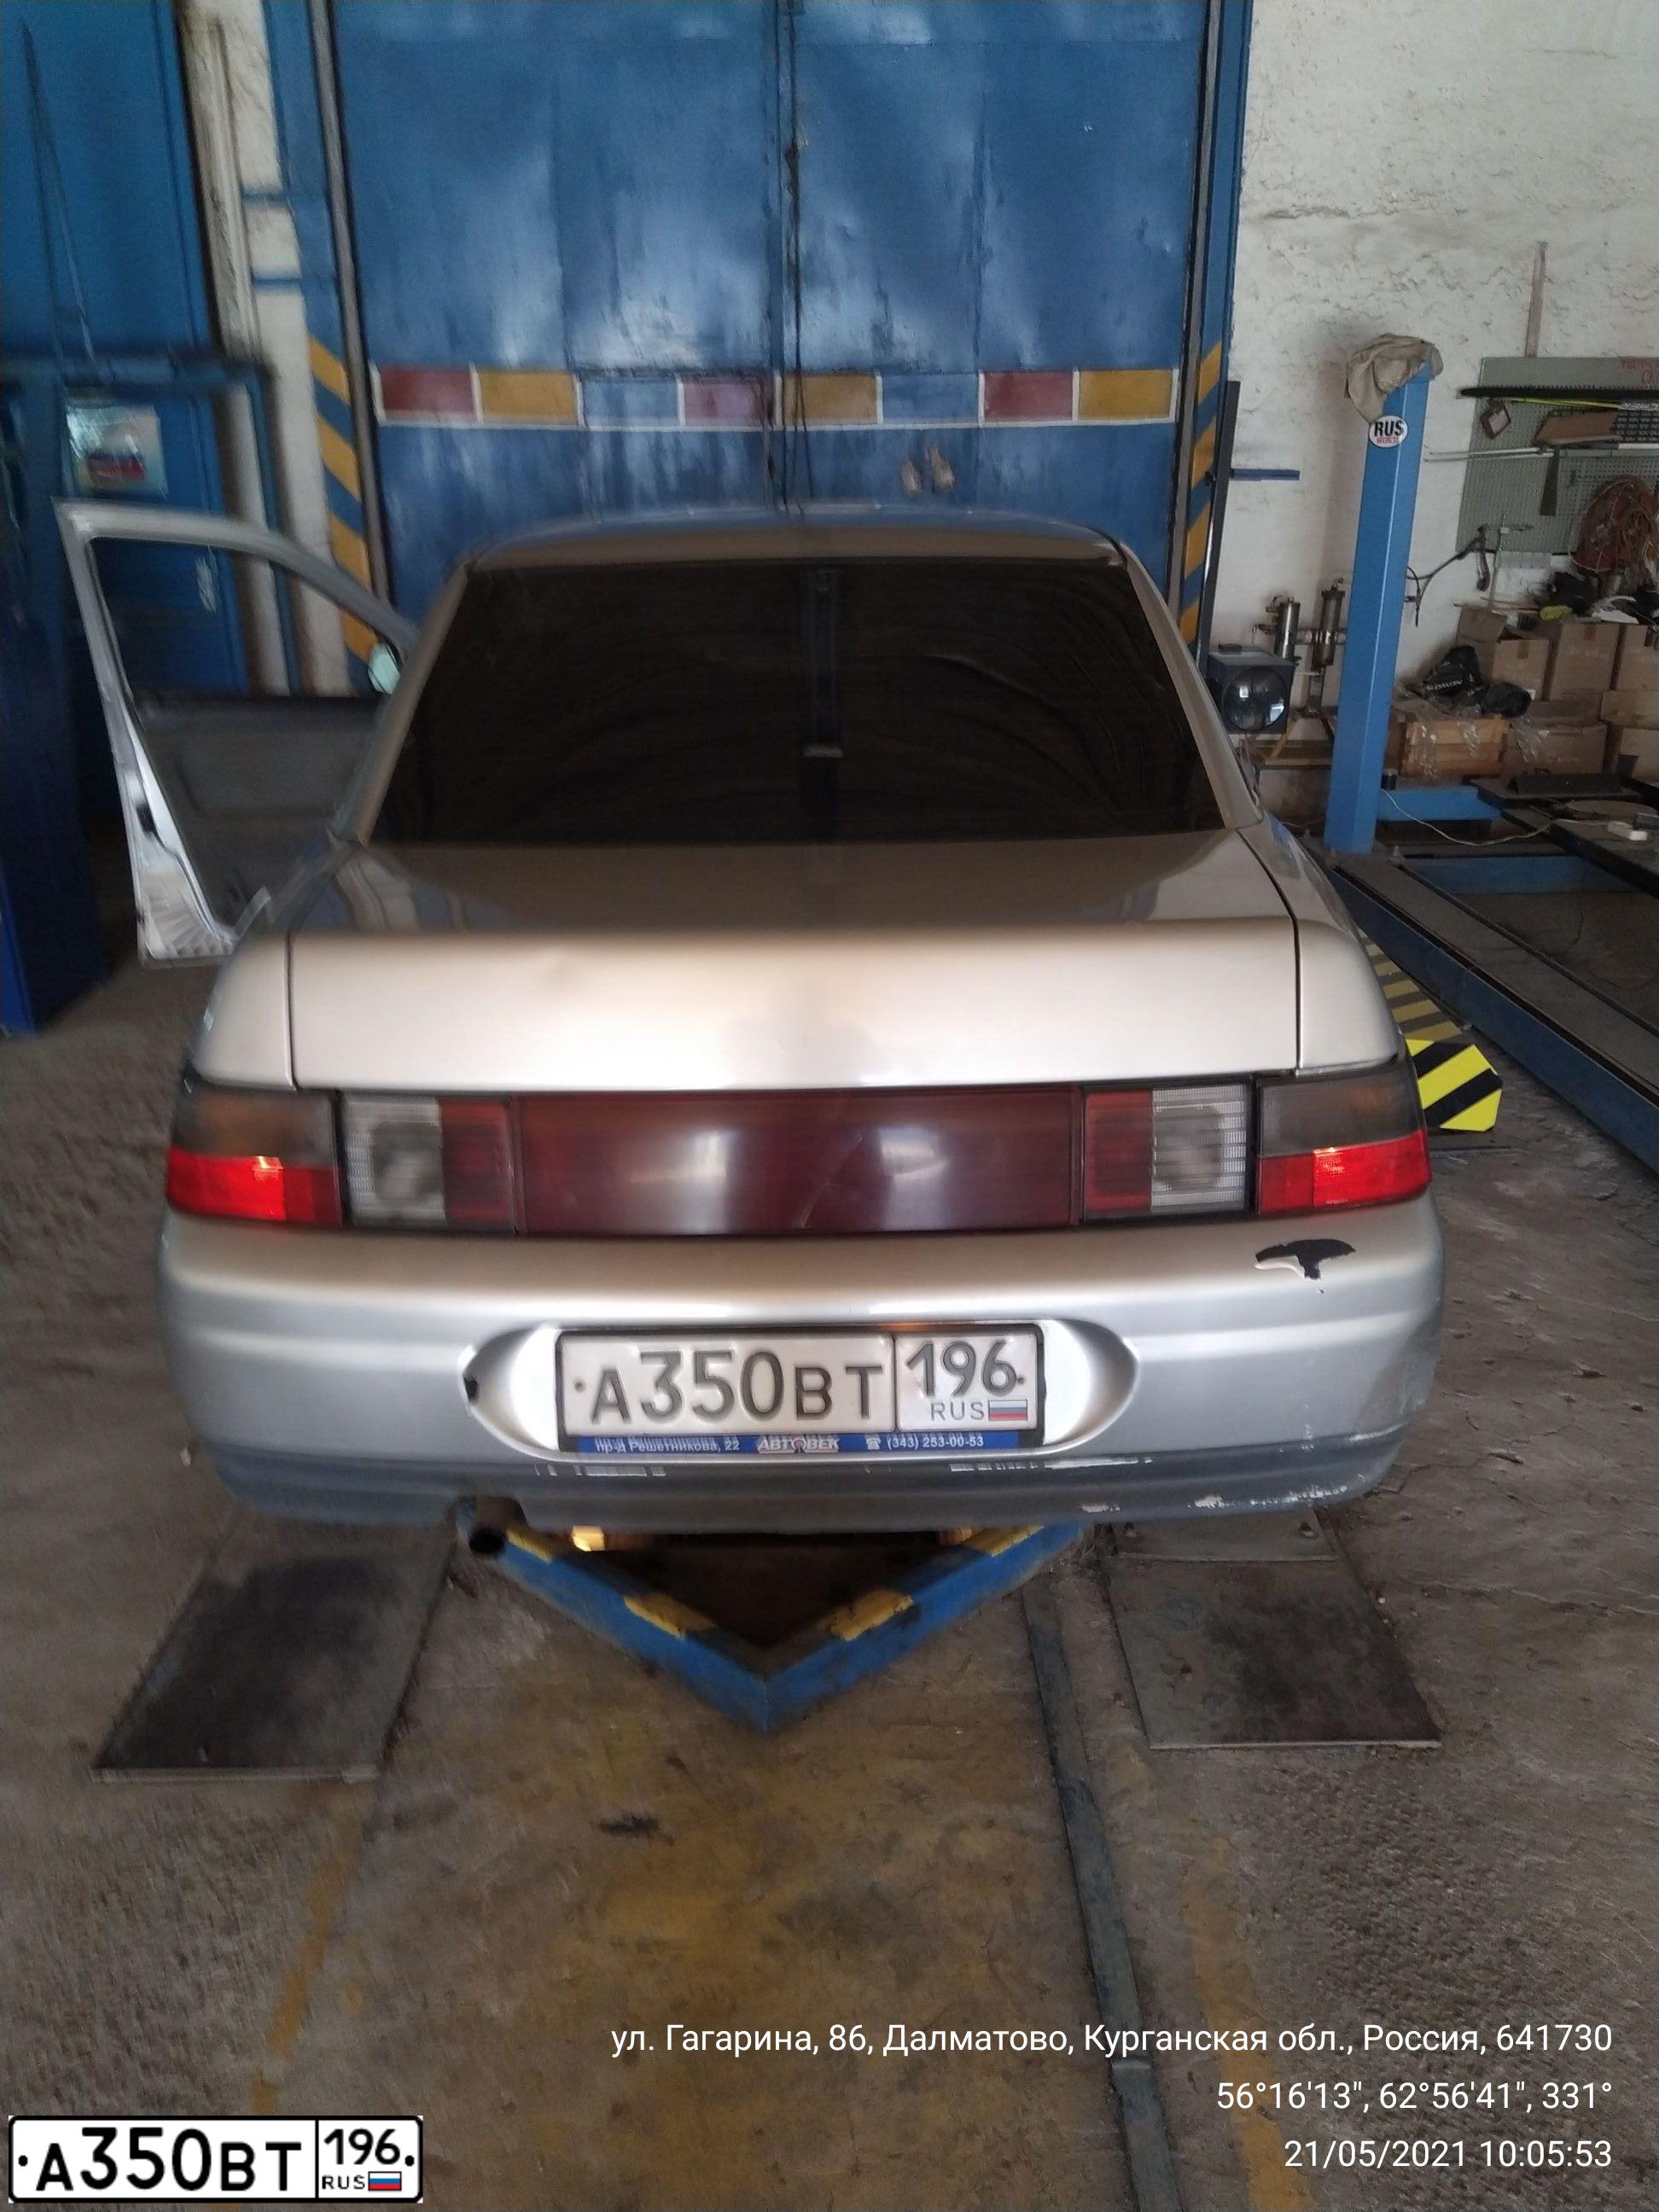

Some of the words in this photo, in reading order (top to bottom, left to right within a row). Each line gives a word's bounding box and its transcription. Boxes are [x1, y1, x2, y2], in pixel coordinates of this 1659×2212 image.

[1374, 420, 1405, 437] RUS
[905, 1339, 1018, 1397] 196
[929, 1402, 985, 1423] RUS
[725, 1438, 741, 1451] 22
[887, 1436, 919, 1450] (343)
[923, 1435, 985, 1448] 253-00-53
